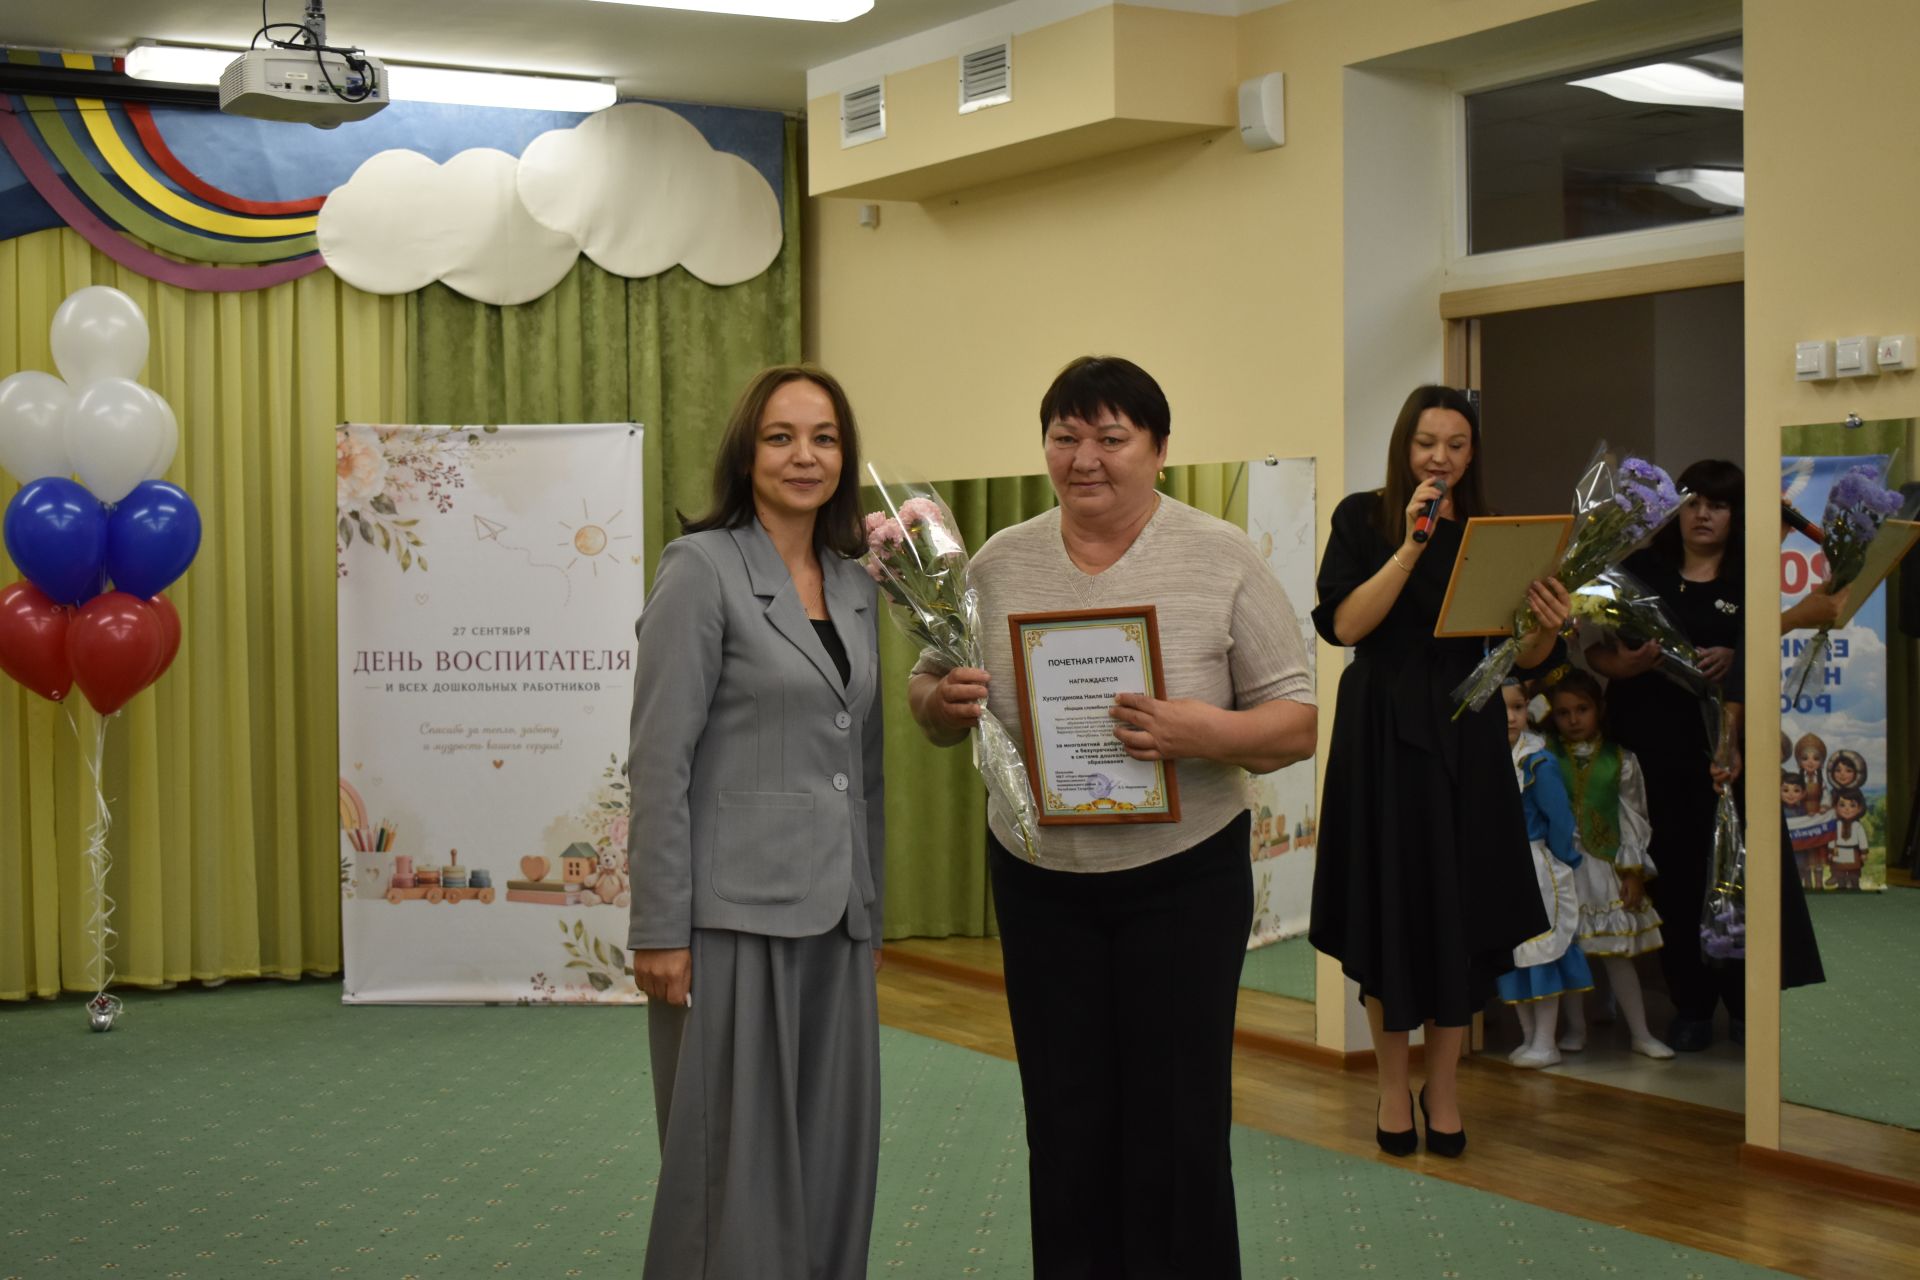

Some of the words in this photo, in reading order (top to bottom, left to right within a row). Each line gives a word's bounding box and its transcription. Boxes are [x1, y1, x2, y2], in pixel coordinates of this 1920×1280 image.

[452, 626, 466, 636] 27
[472, 626, 531, 636] СЕНТЯБРЯ
[353, 650, 423, 675] ДЕНЬ
[436, 650, 631, 671] ВОСПИТАТЕЛЯ
[1048, 657, 1093, 667] ПОЧЕТНАЯ
[1095, 655, 1135, 665] ГРАМОТА
[1069, 676, 1118, 685] НАГРАЖДАЕТСЯ
[386, 682, 393, 692] И
[399, 682, 428, 692] ВСЕХ
[433, 682, 517, 694] ДОШКОЛЬНЫХ
[523, 681, 601, 692] РАБОТНИКОВ
